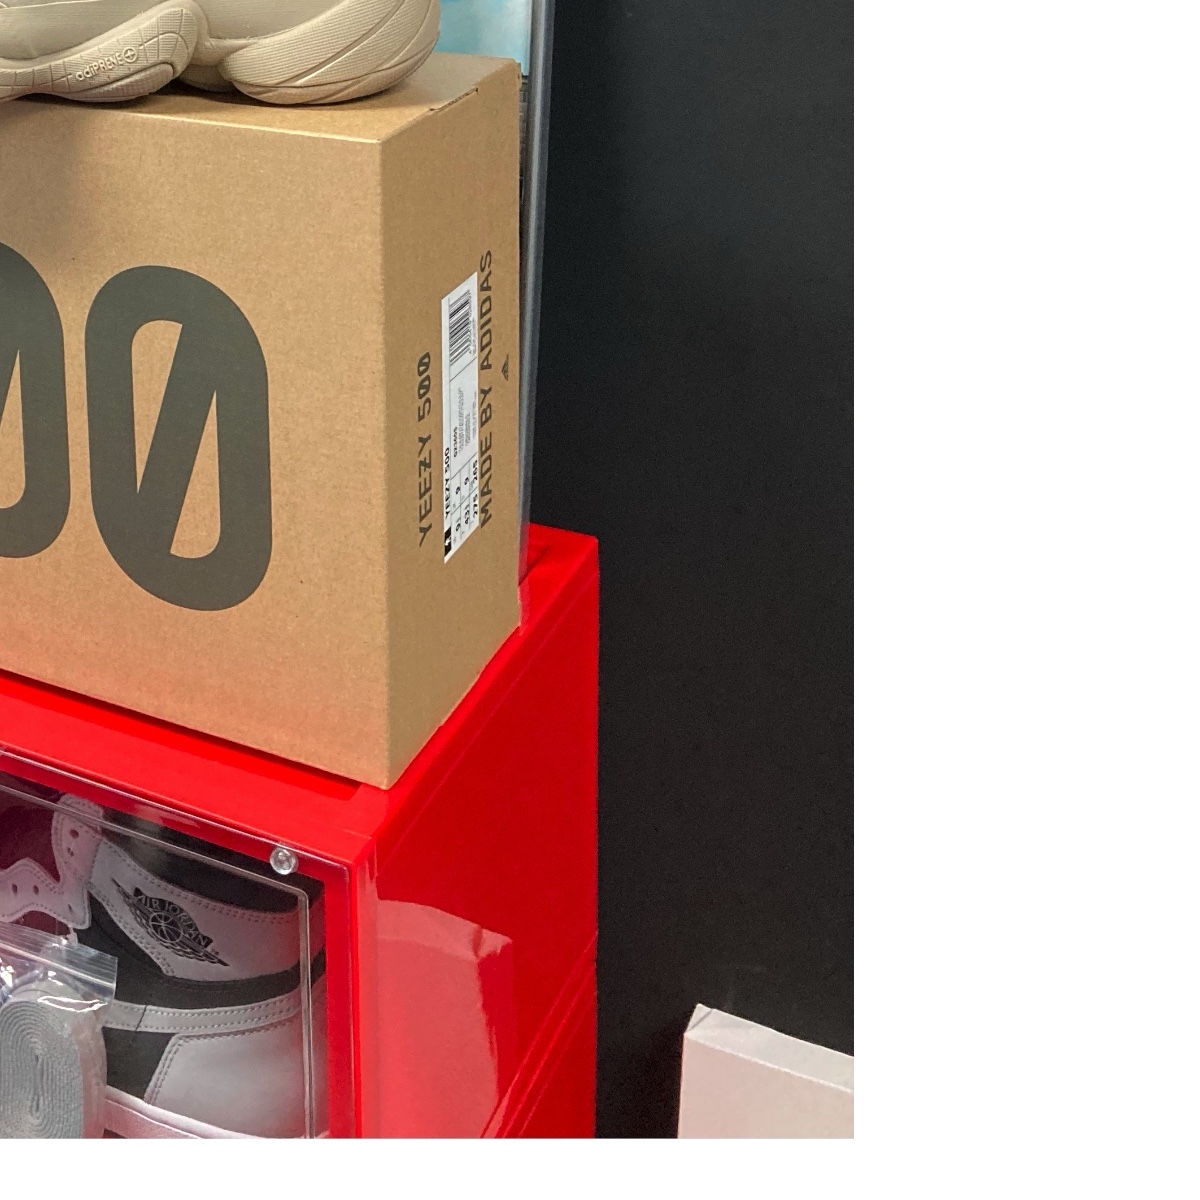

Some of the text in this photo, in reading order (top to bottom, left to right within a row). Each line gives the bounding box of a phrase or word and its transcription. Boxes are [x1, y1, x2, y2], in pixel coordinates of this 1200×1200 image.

[417, 351, 433, 548] YEEZY 500
[480, 249, 492, 529] MADE BY ADIDAS
[136, 894, 161, 911] AIR
